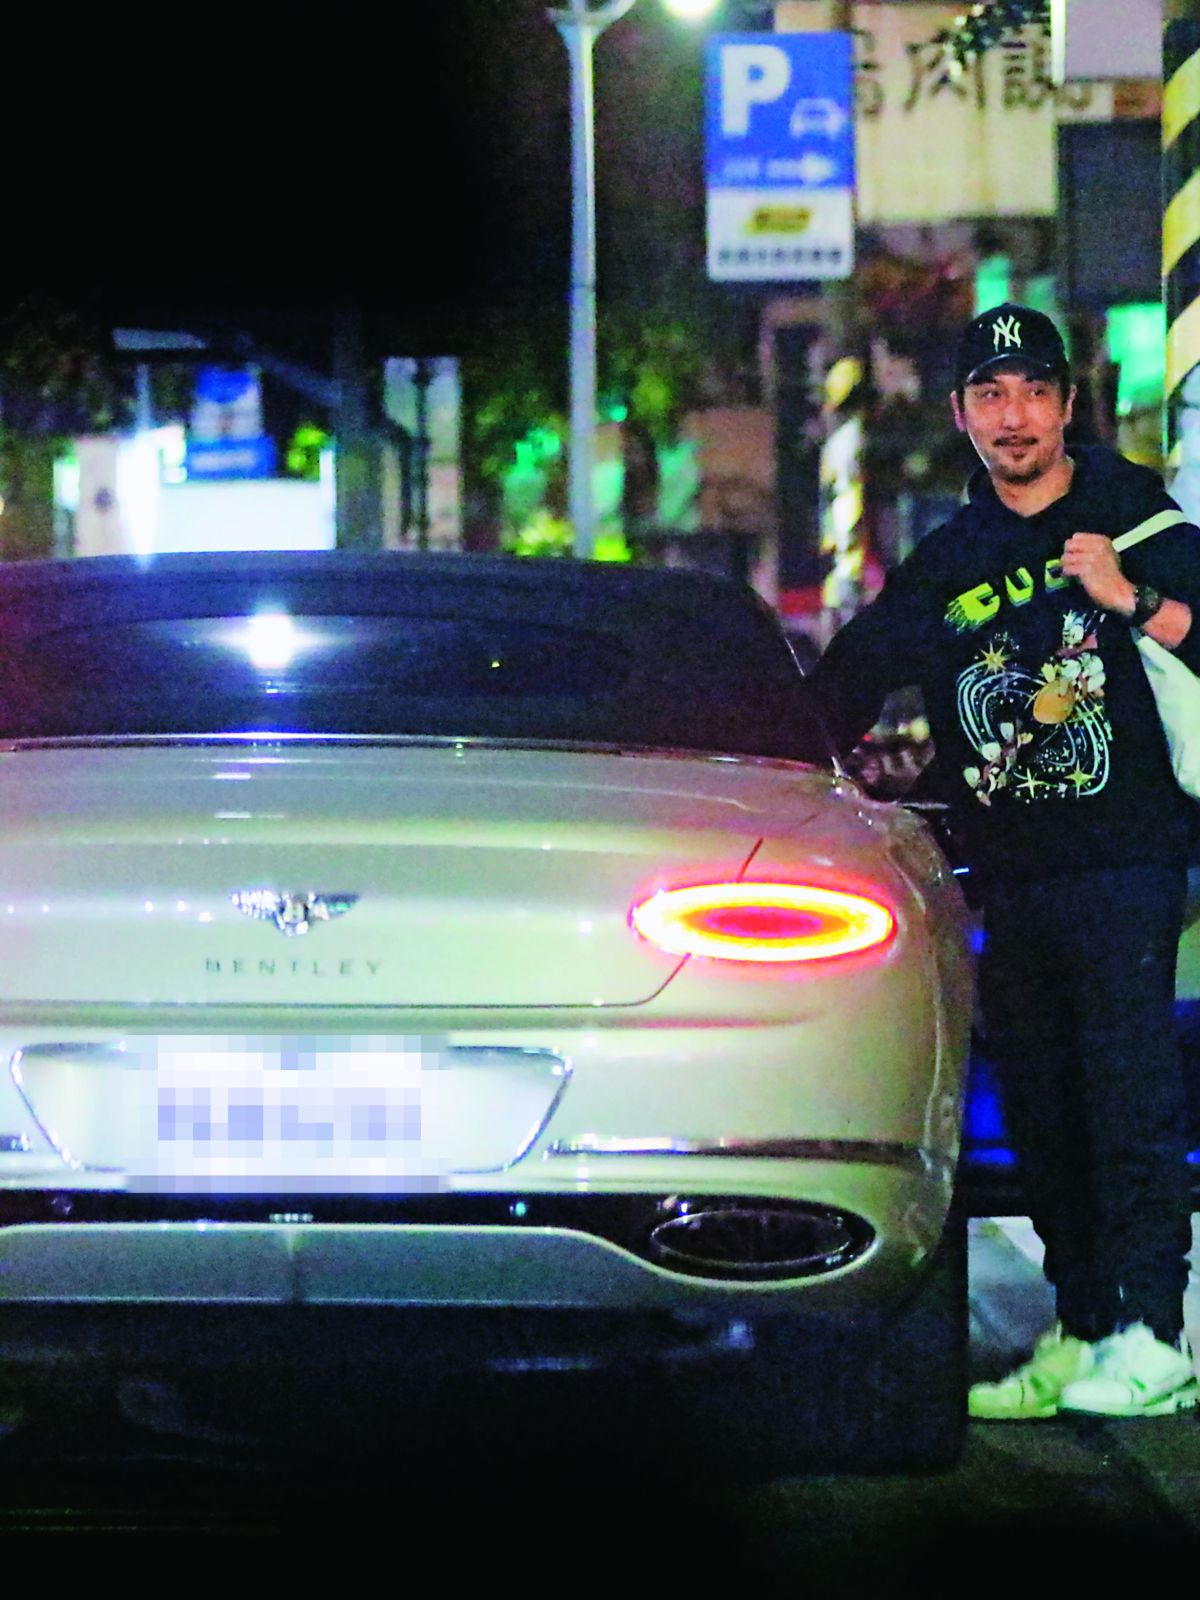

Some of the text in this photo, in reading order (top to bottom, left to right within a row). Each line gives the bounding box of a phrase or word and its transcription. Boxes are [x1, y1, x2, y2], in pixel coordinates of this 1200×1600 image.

[720, 44, 791, 137] P
[992, 314, 1022, 353] NY
[205, 957, 382, 976] BENTLEY
